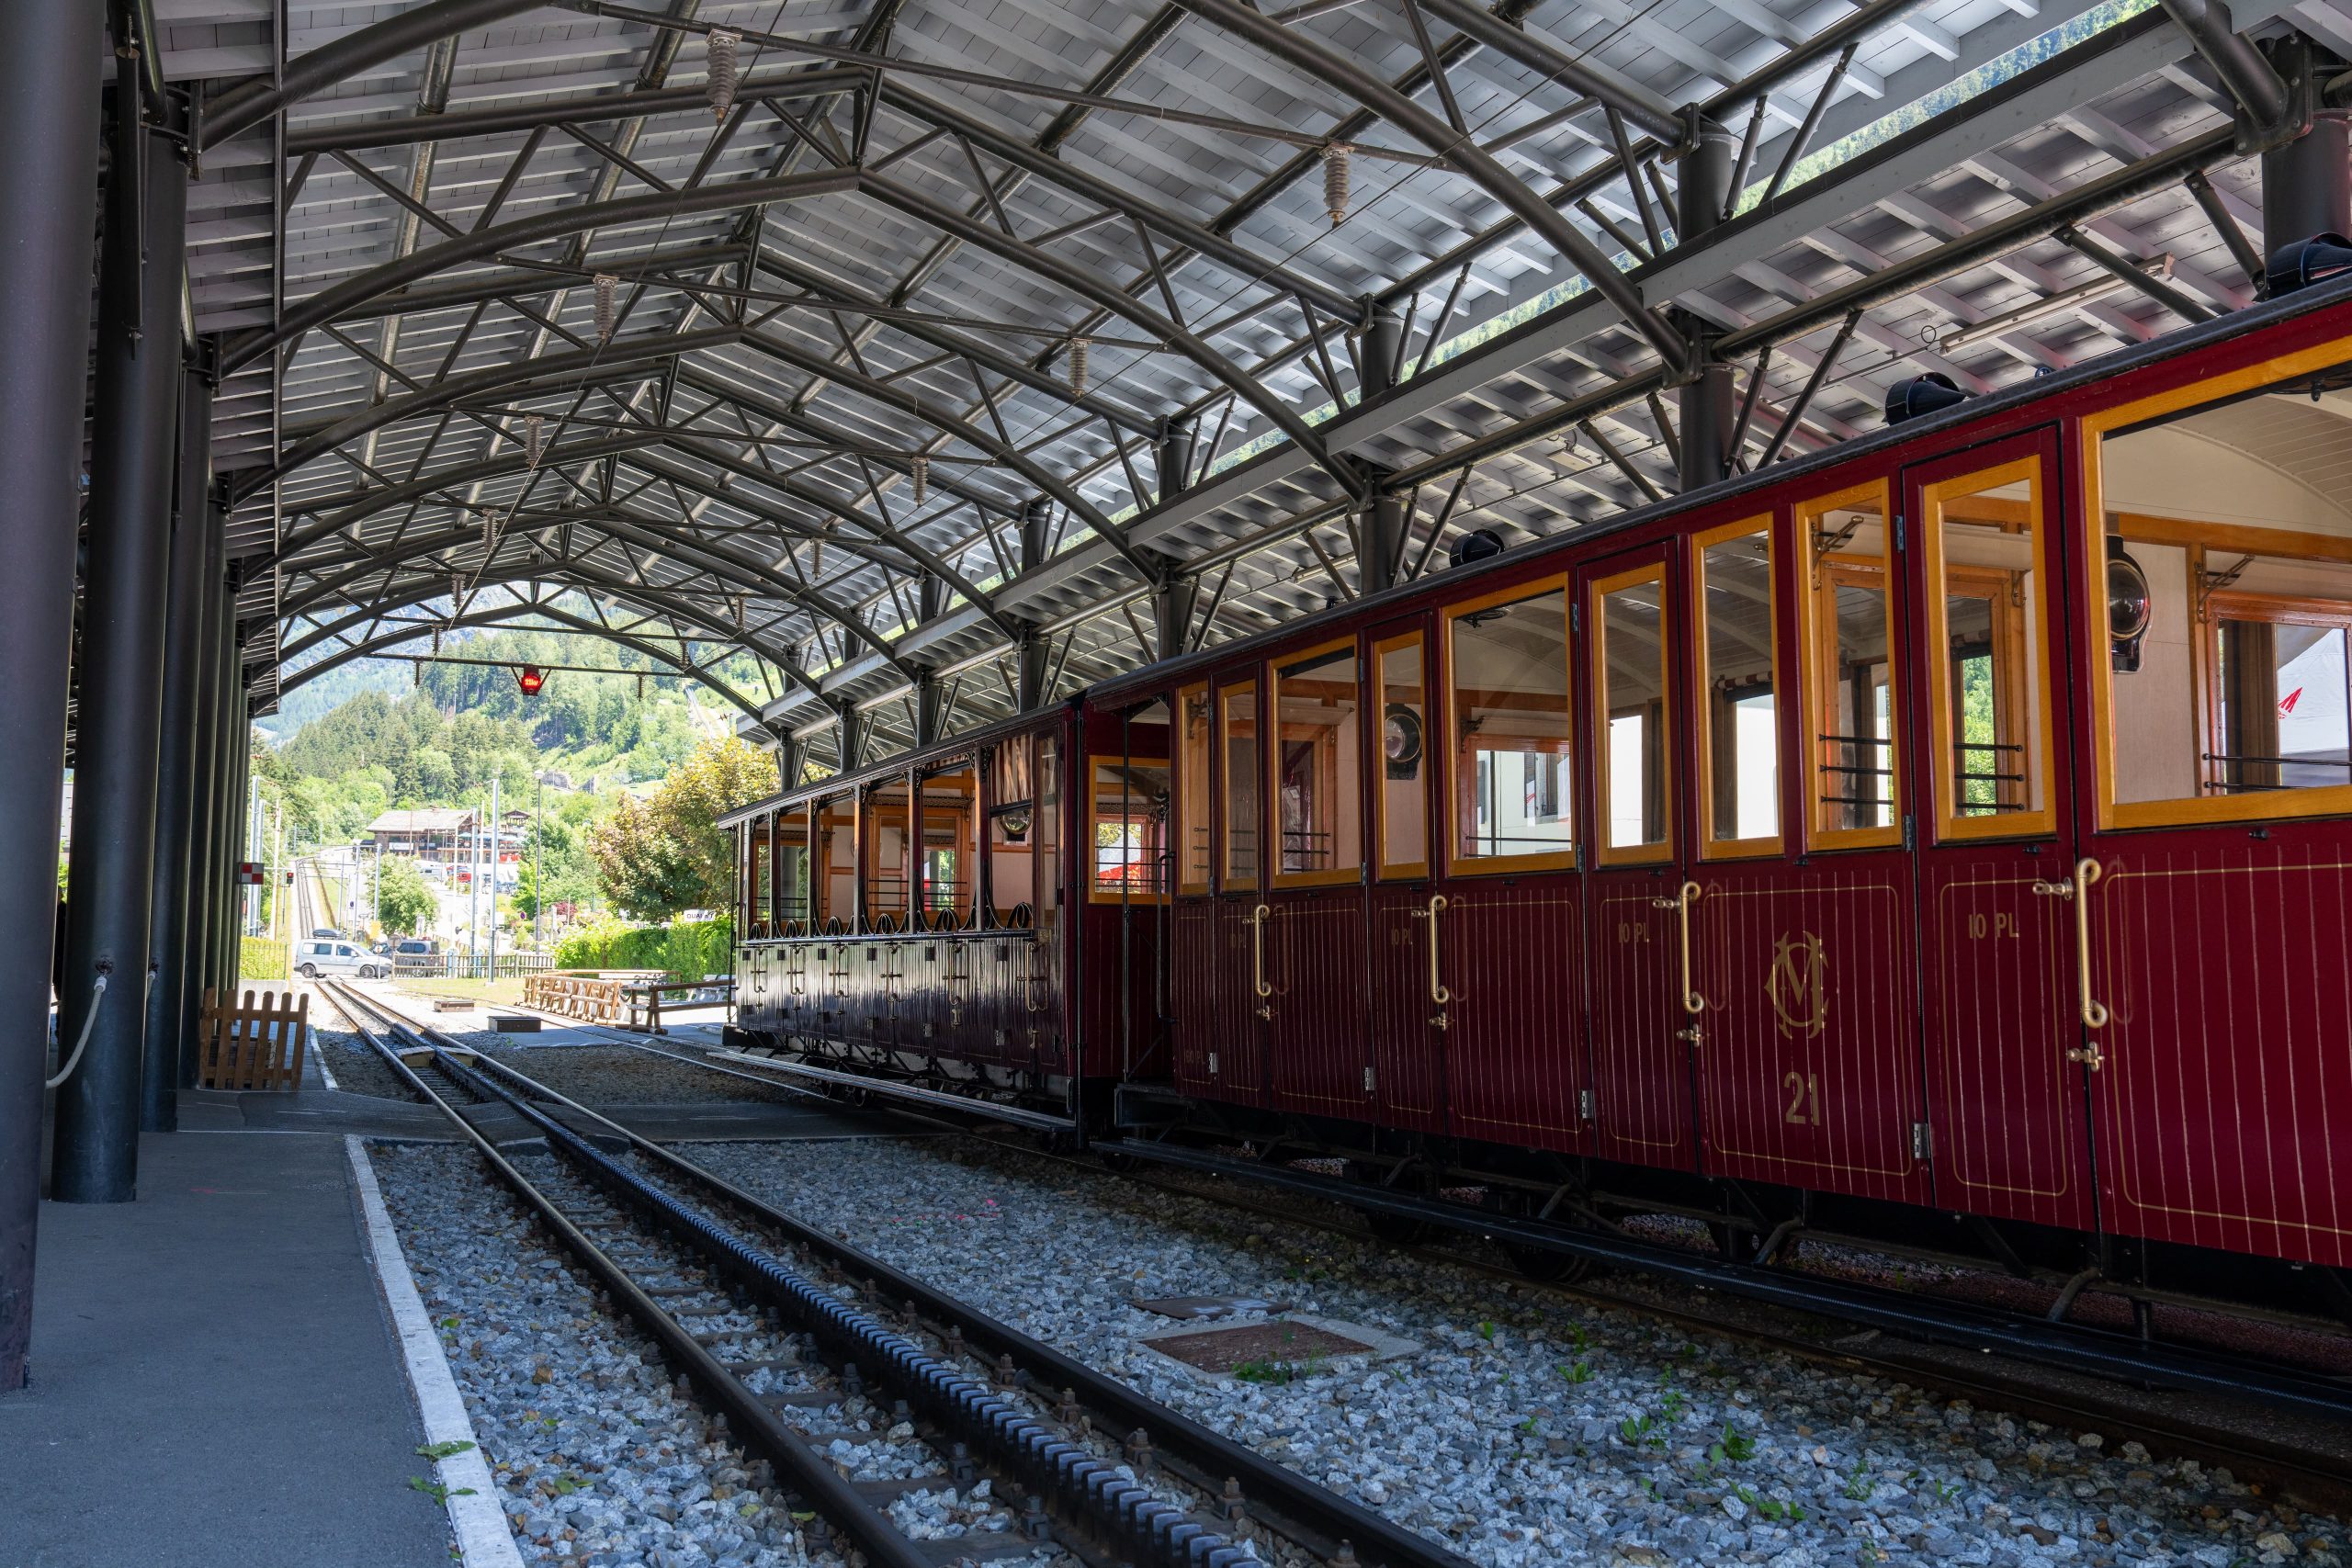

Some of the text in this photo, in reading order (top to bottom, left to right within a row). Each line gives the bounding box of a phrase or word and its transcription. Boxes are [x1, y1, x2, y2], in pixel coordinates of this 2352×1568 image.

[1391, 928, 1412, 945] 10 PL
[1618, 922, 1649, 943] 10 PL
[1969, 912, 2019, 939] 10 PL
[1783, 1071, 1821, 1127] 21
